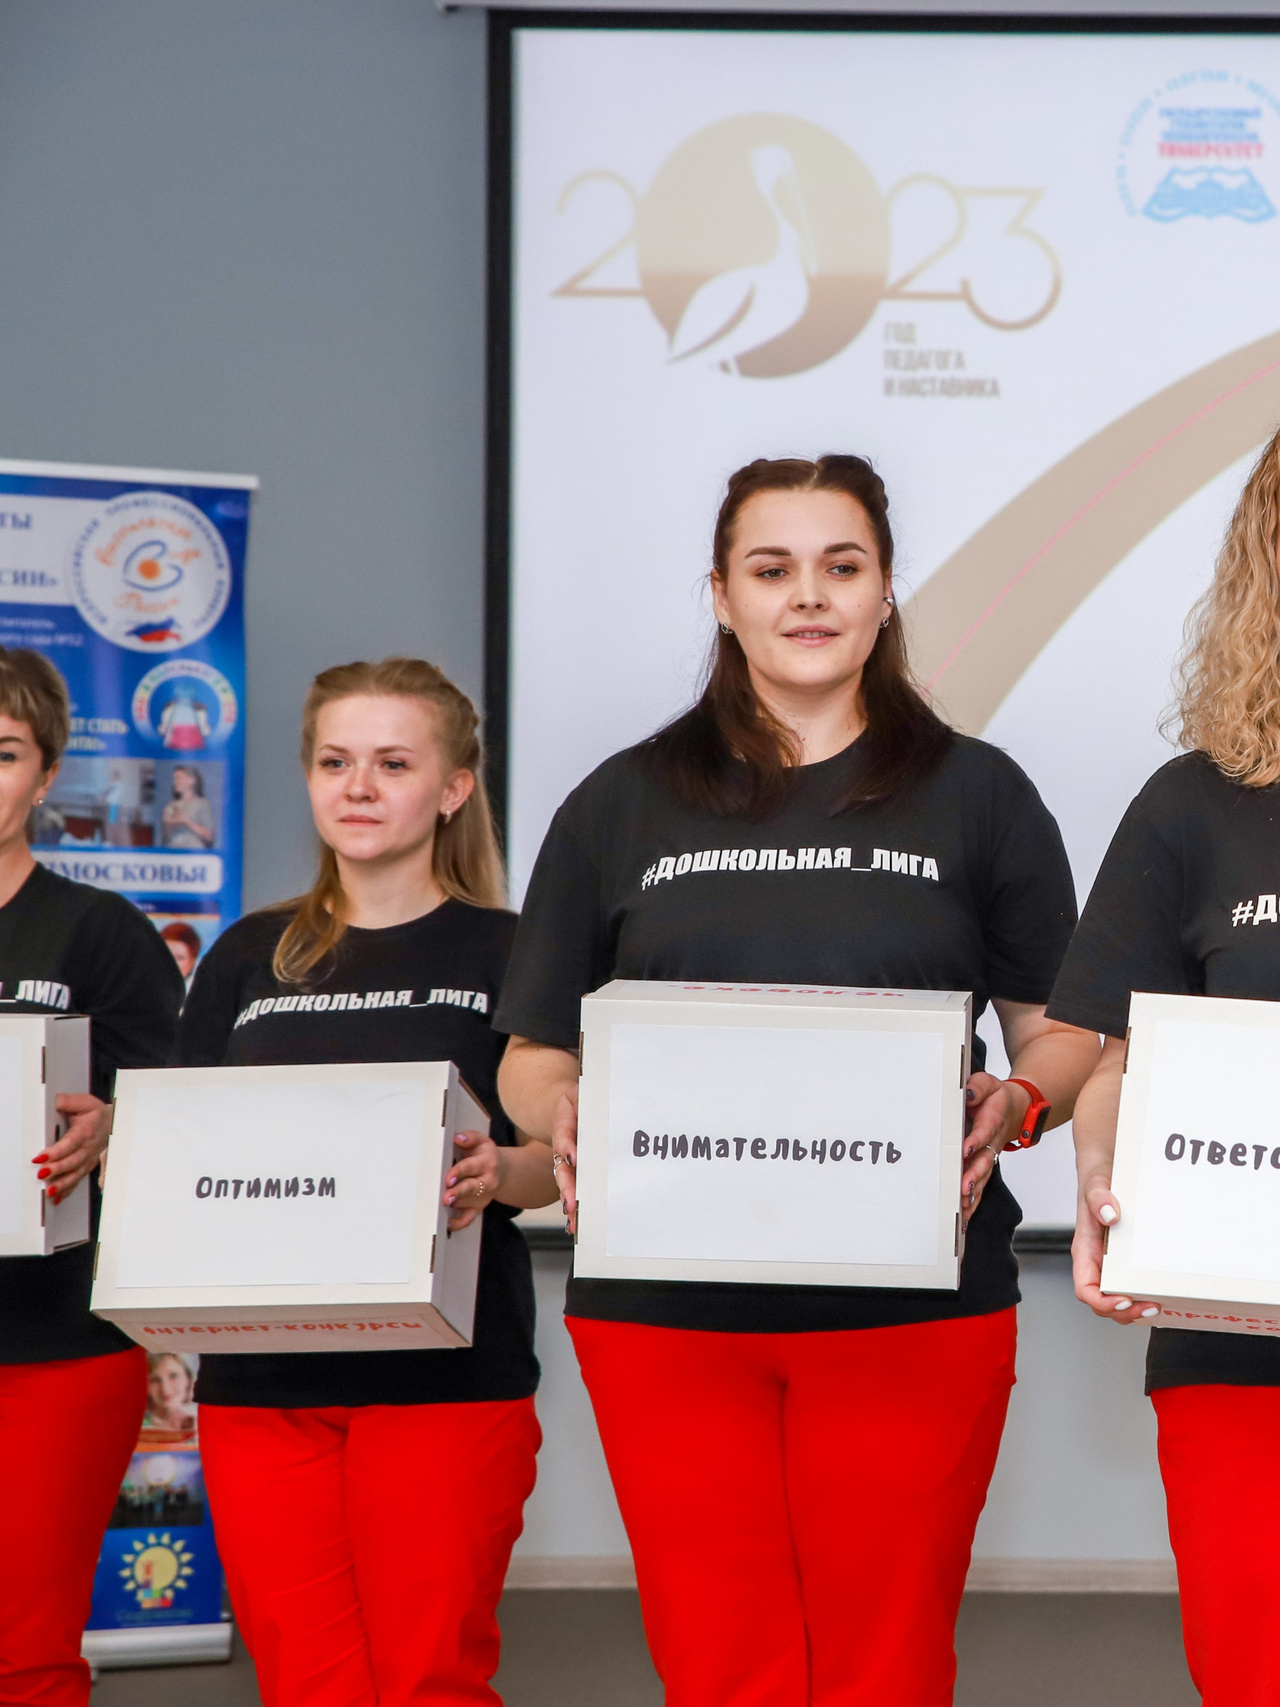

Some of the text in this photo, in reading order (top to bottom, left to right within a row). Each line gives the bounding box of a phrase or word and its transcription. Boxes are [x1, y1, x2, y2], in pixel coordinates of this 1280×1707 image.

[884, 322, 916, 344] ГОД
[884, 350, 966, 371] ПЕДАГОГА
[884, 377, 1000, 398] И НАСТАВНИКА
[51, 861, 208, 884] МОСКОВЬЯ
[641, 847, 940, 891] #ДОШКОЛЬНАЯ_ЛИГА
[233, 988, 488, 1030] #ДОШКОЛЬНАЯ_ЛИГА
[631, 1128, 903, 1165] Внимательность
[194, 1175, 337, 1200] Оптимизм
